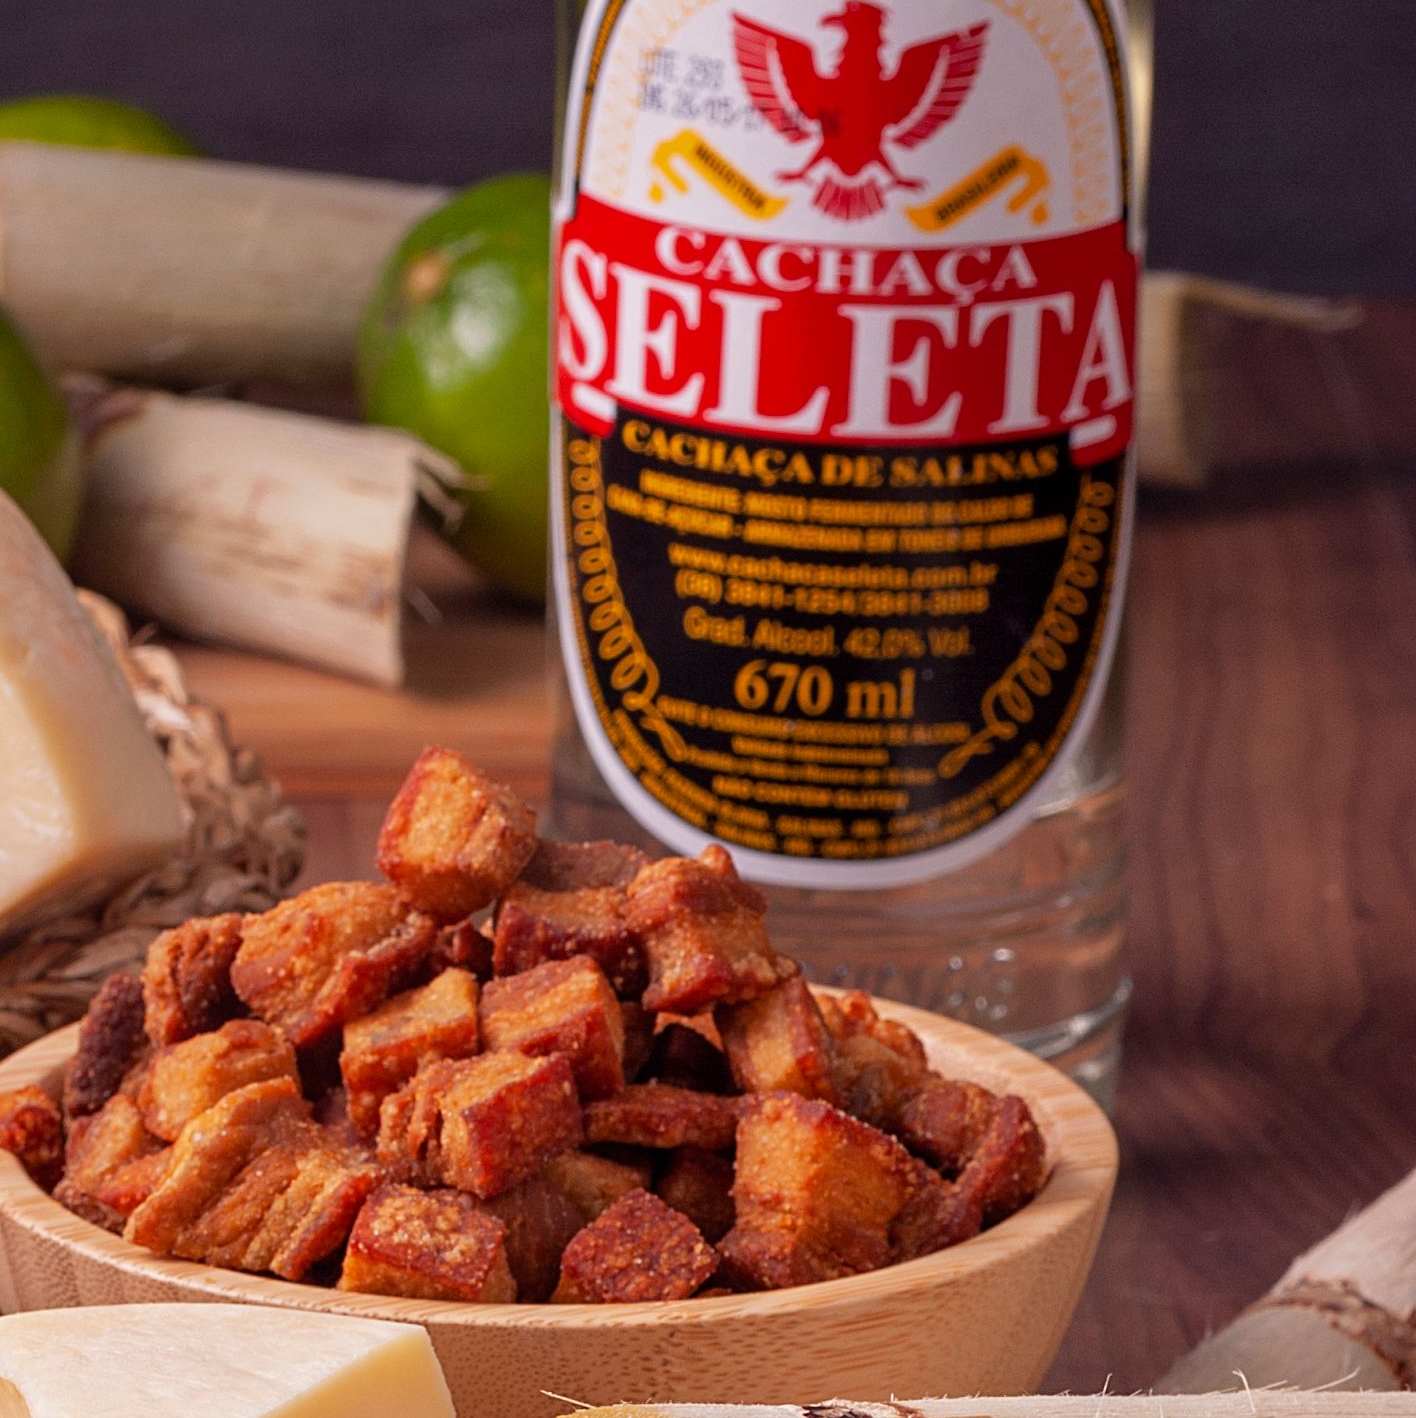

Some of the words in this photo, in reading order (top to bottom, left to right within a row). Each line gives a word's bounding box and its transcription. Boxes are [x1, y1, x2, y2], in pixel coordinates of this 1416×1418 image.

[654, 226, 1039, 307] CACHAÇA
[558, 239, 1134, 439] SELETA
[622, 421, 814, 486] CACHAÇA
[821, 455, 884, 487] DE
[889, 445, 1059, 488] SALINAS
[734, 658, 833, 716] 670
[847, 666, 916, 719] ml
